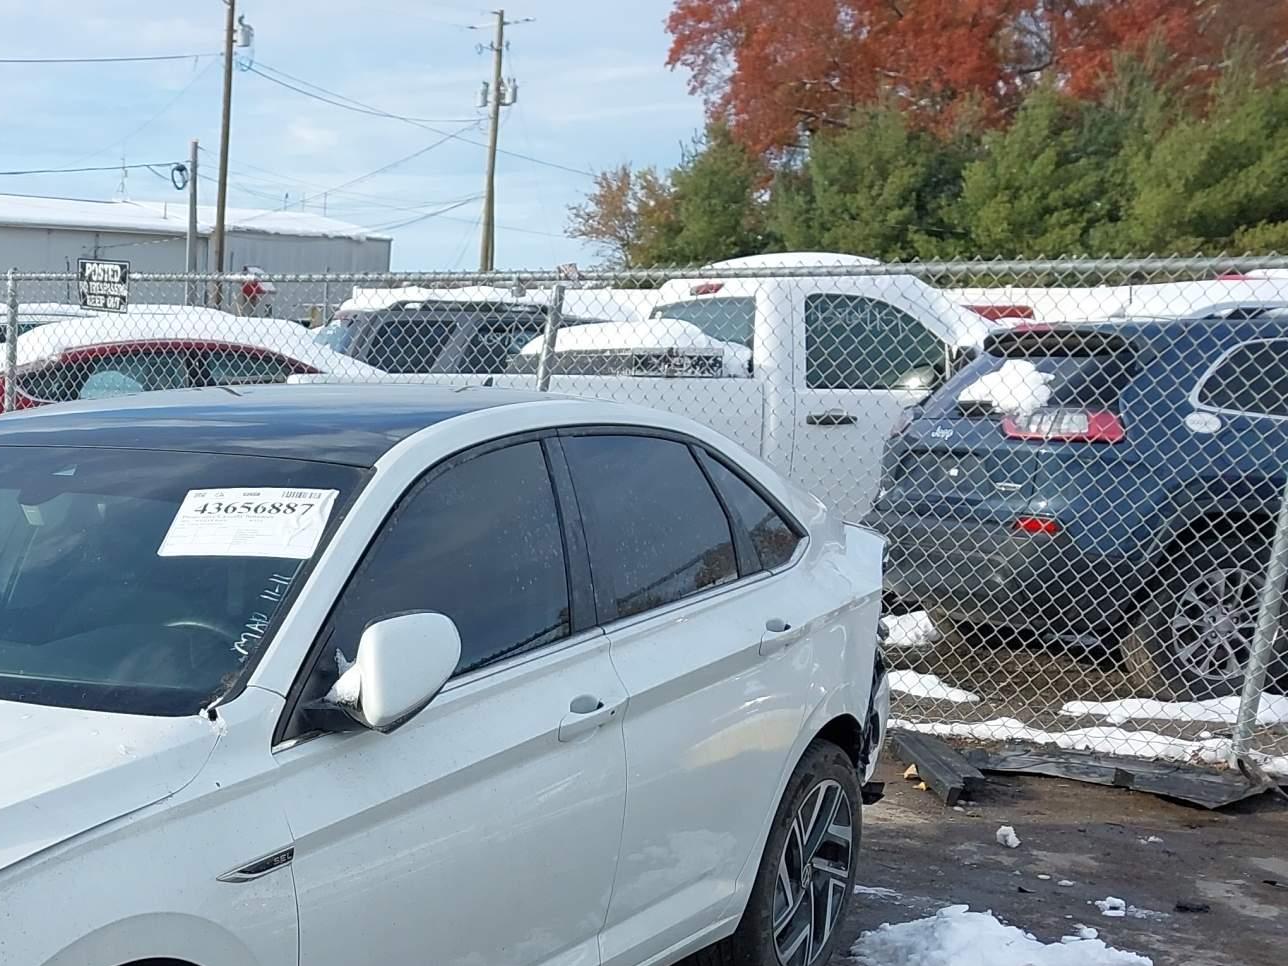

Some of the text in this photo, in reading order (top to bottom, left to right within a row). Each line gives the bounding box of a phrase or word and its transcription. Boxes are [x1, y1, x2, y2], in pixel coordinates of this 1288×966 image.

[85, 263, 121, 282] POSTED
[86, 295, 121, 309] KEEP OUT
[194, 501, 315, 516] 43656887
[273, 851, 292, 865] SEL
